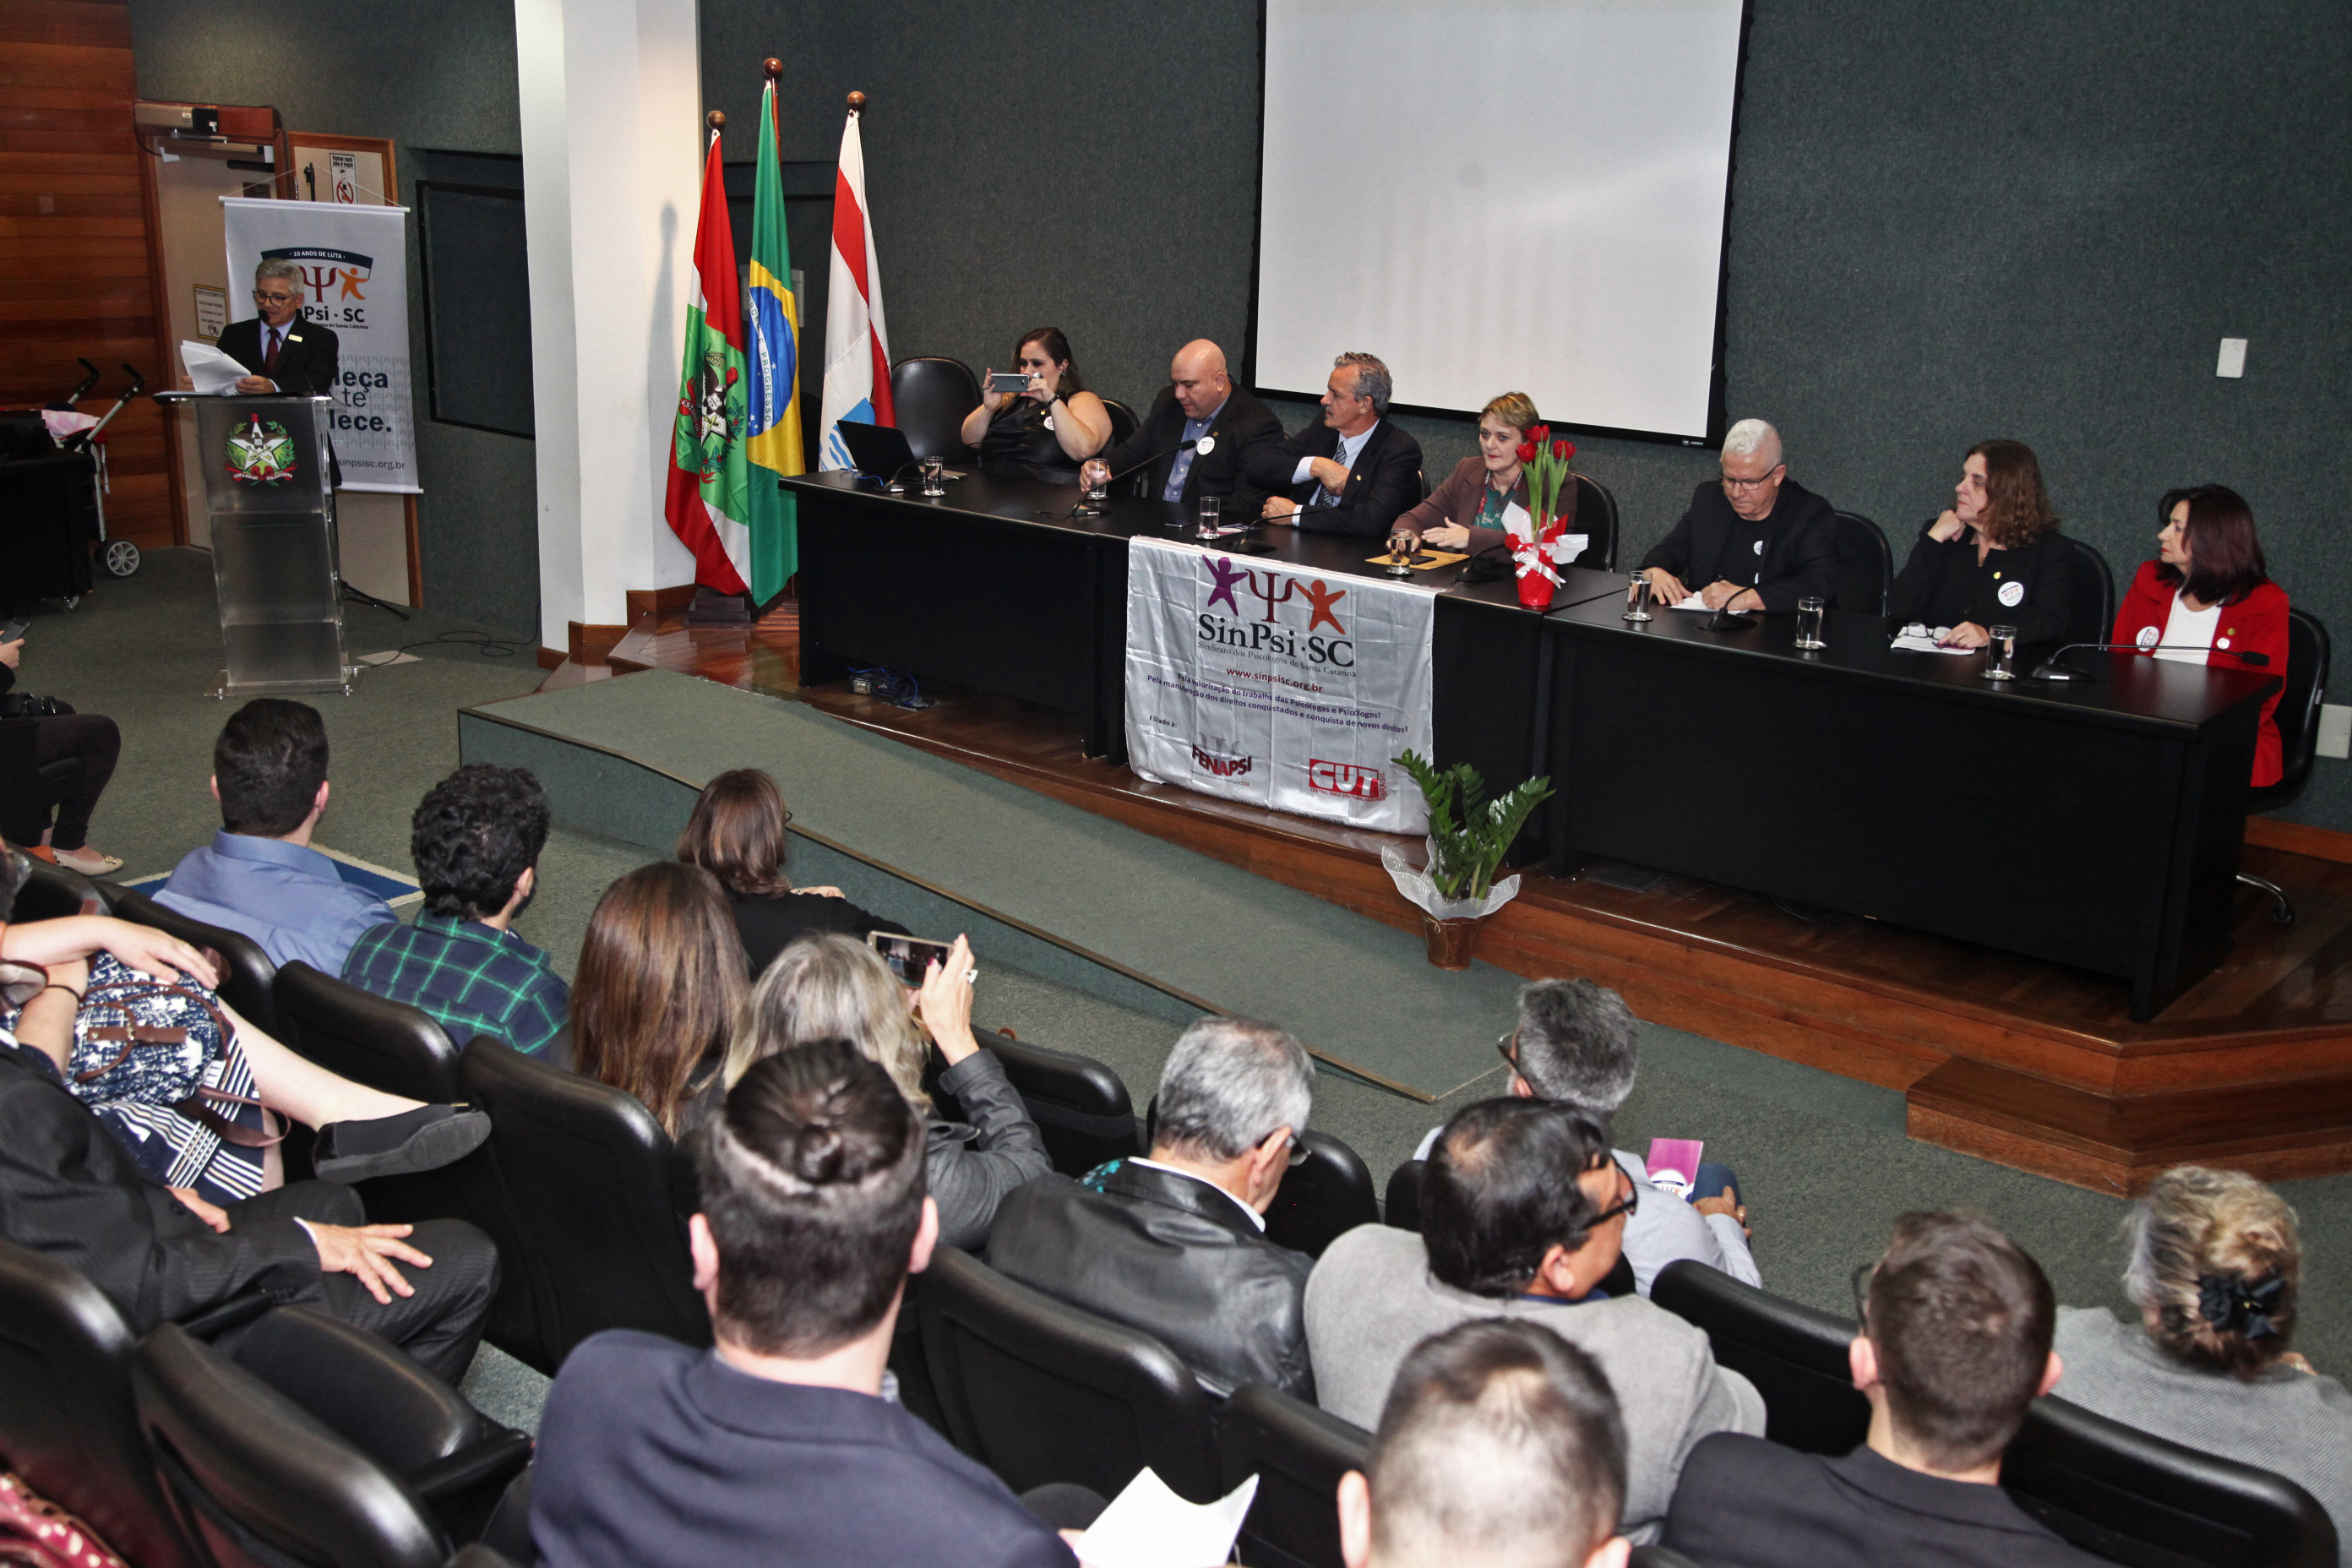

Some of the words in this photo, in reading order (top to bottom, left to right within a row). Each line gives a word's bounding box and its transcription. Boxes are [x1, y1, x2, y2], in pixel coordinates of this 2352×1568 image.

[304, 306, 329, 321] Psi
[343, 308, 365, 323] SC
[760, 351, 772, 422] PROGRESSO
[681, 399, 698, 422] ESTADO
[338, 460, 406, 470] sinpsisc.org.br
[1198, 640, 1232, 655] Sindicato
[1233, 649, 1245, 657] dos
[1249, 651, 1288, 665] Psicólogos
[1301, 662, 1321, 673] Santa
[1323, 667, 1356, 678] Catarina
[1227, 667, 1323, 693] www.sinpsisc.org.br
[1147, 675, 1162, 684] Pela
[1163, 681, 1204, 698] manutenção
[1206, 693, 1218, 701] dos
[1220, 696, 1247, 708] direitos
[1306, 713, 1343, 726] conquista
[1357, 721, 1380, 730] novos
[1178, 673, 1191, 683] Pela
[1192, 679, 1230, 694] valorização
[1244, 690, 1272, 701] trabalho
[1276, 694, 1288, 704] das
[1290, 700, 1330, 713] Psicólogas
[1338, 708, 1380, 719] Psicólogos!
[1149, 715, 1170, 727] Filiado
[1192, 743, 1252, 776] FENAPSI
[1310, 787, 1328, 796] CENTRAL
[1311, 762, 1379, 796] CUT
